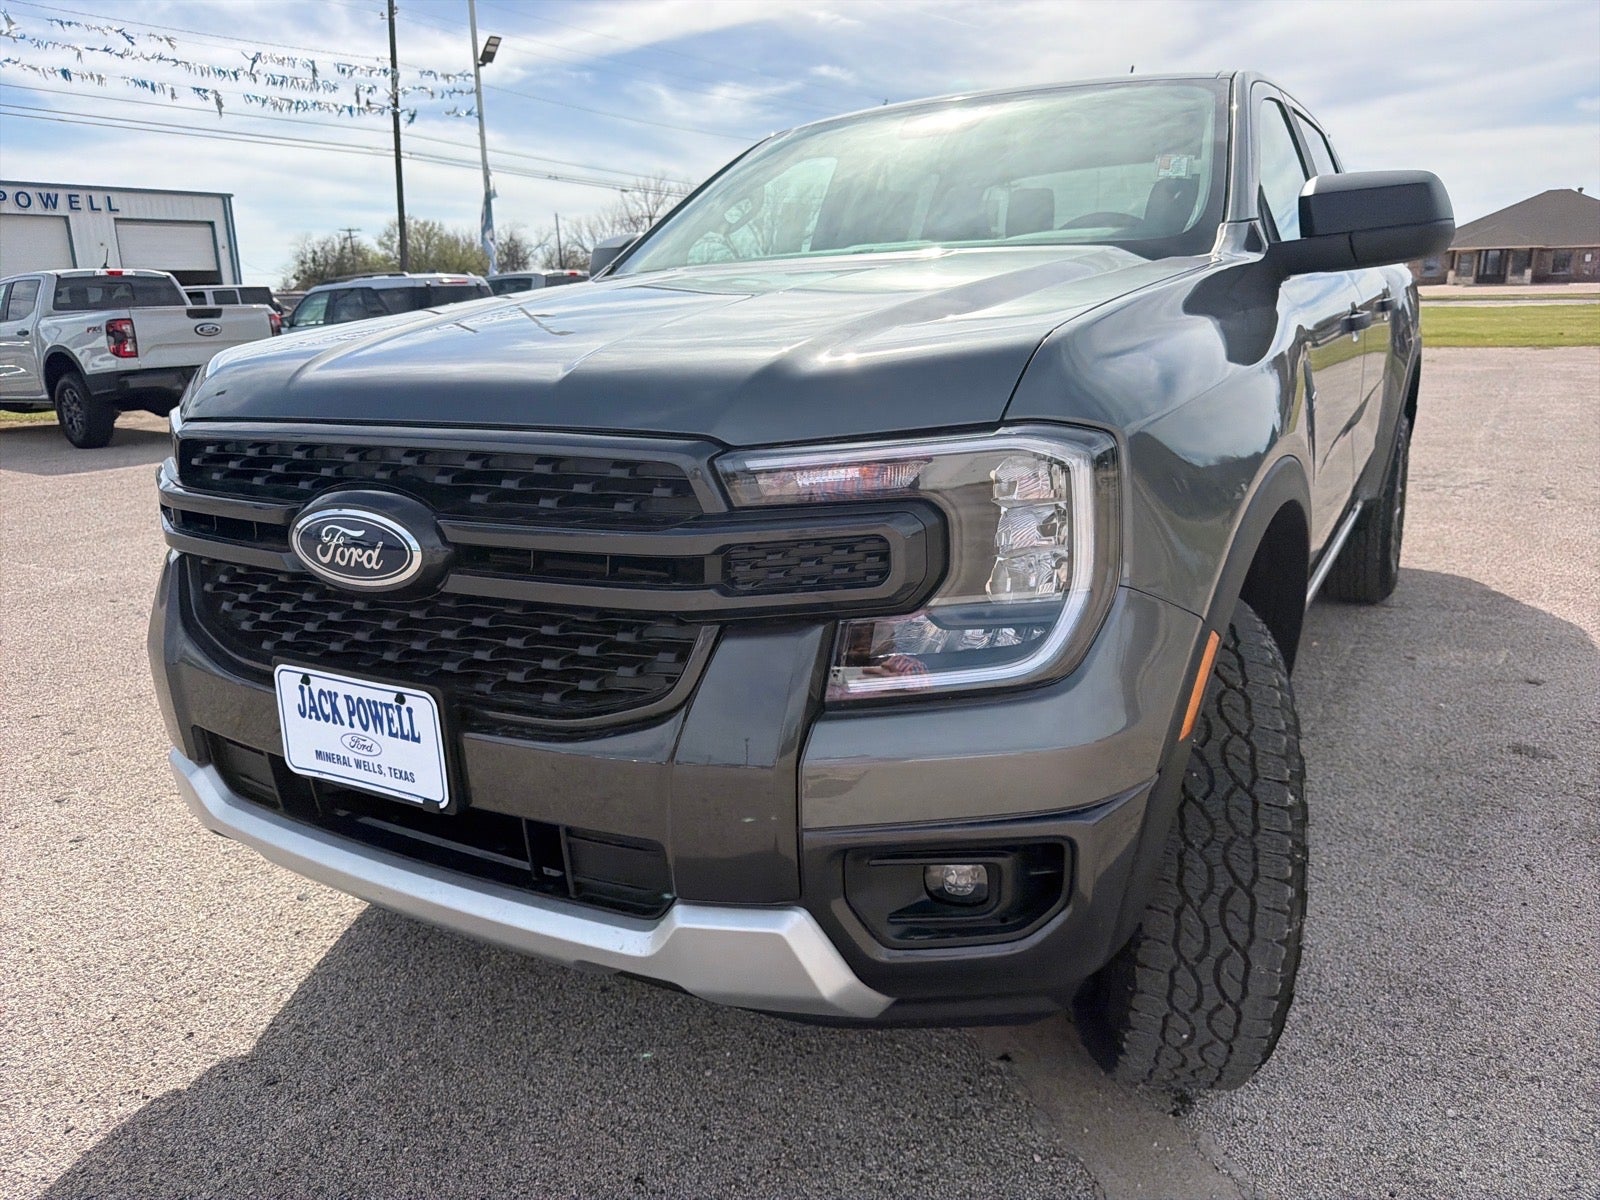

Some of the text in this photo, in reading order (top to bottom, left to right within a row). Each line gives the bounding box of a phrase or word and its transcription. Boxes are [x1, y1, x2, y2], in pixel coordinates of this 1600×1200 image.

[0, 190, 120, 212] POWELL
[316, 524, 384, 570] Ford
[297, 684, 421, 744] JACK POWELL
[349, 735, 374, 753] Ford
[315, 749, 416, 784] MINERAL WELLS, TEXAS
